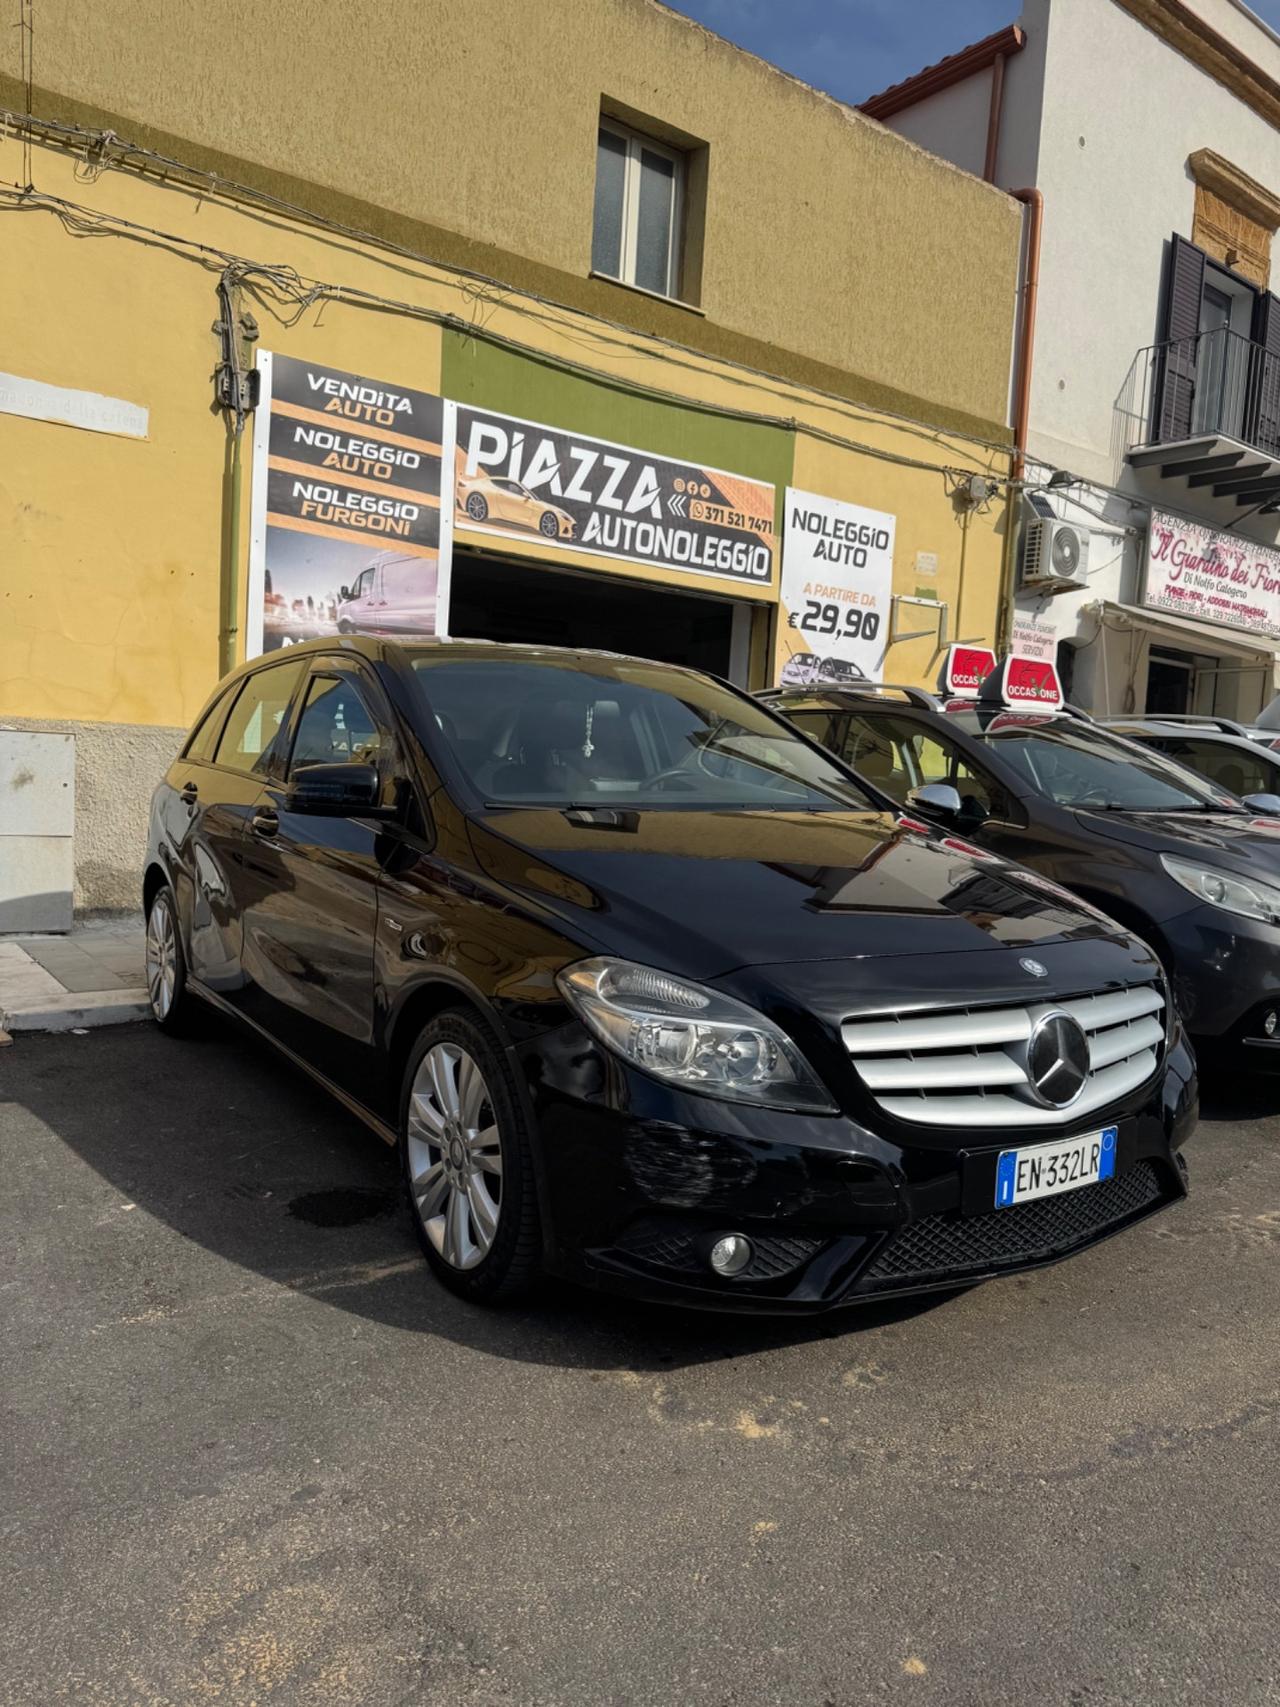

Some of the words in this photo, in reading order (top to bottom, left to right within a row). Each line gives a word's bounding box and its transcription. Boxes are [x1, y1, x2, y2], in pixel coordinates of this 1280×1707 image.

[324, 398, 395, 427] AUTO
[322, 452, 393, 480] AUTO
[705, 506, 724, 523] 371
[728, 511, 745, 528] 521
[748, 515, 773, 534] 7471
[813, 538, 867, 568] AUTO
[803, 582, 812, 595] A
[861, 593, 876, 607] DA
[952, 673, 986, 685] OCCAS
[1008, 684, 1058, 699] OCCASONE
